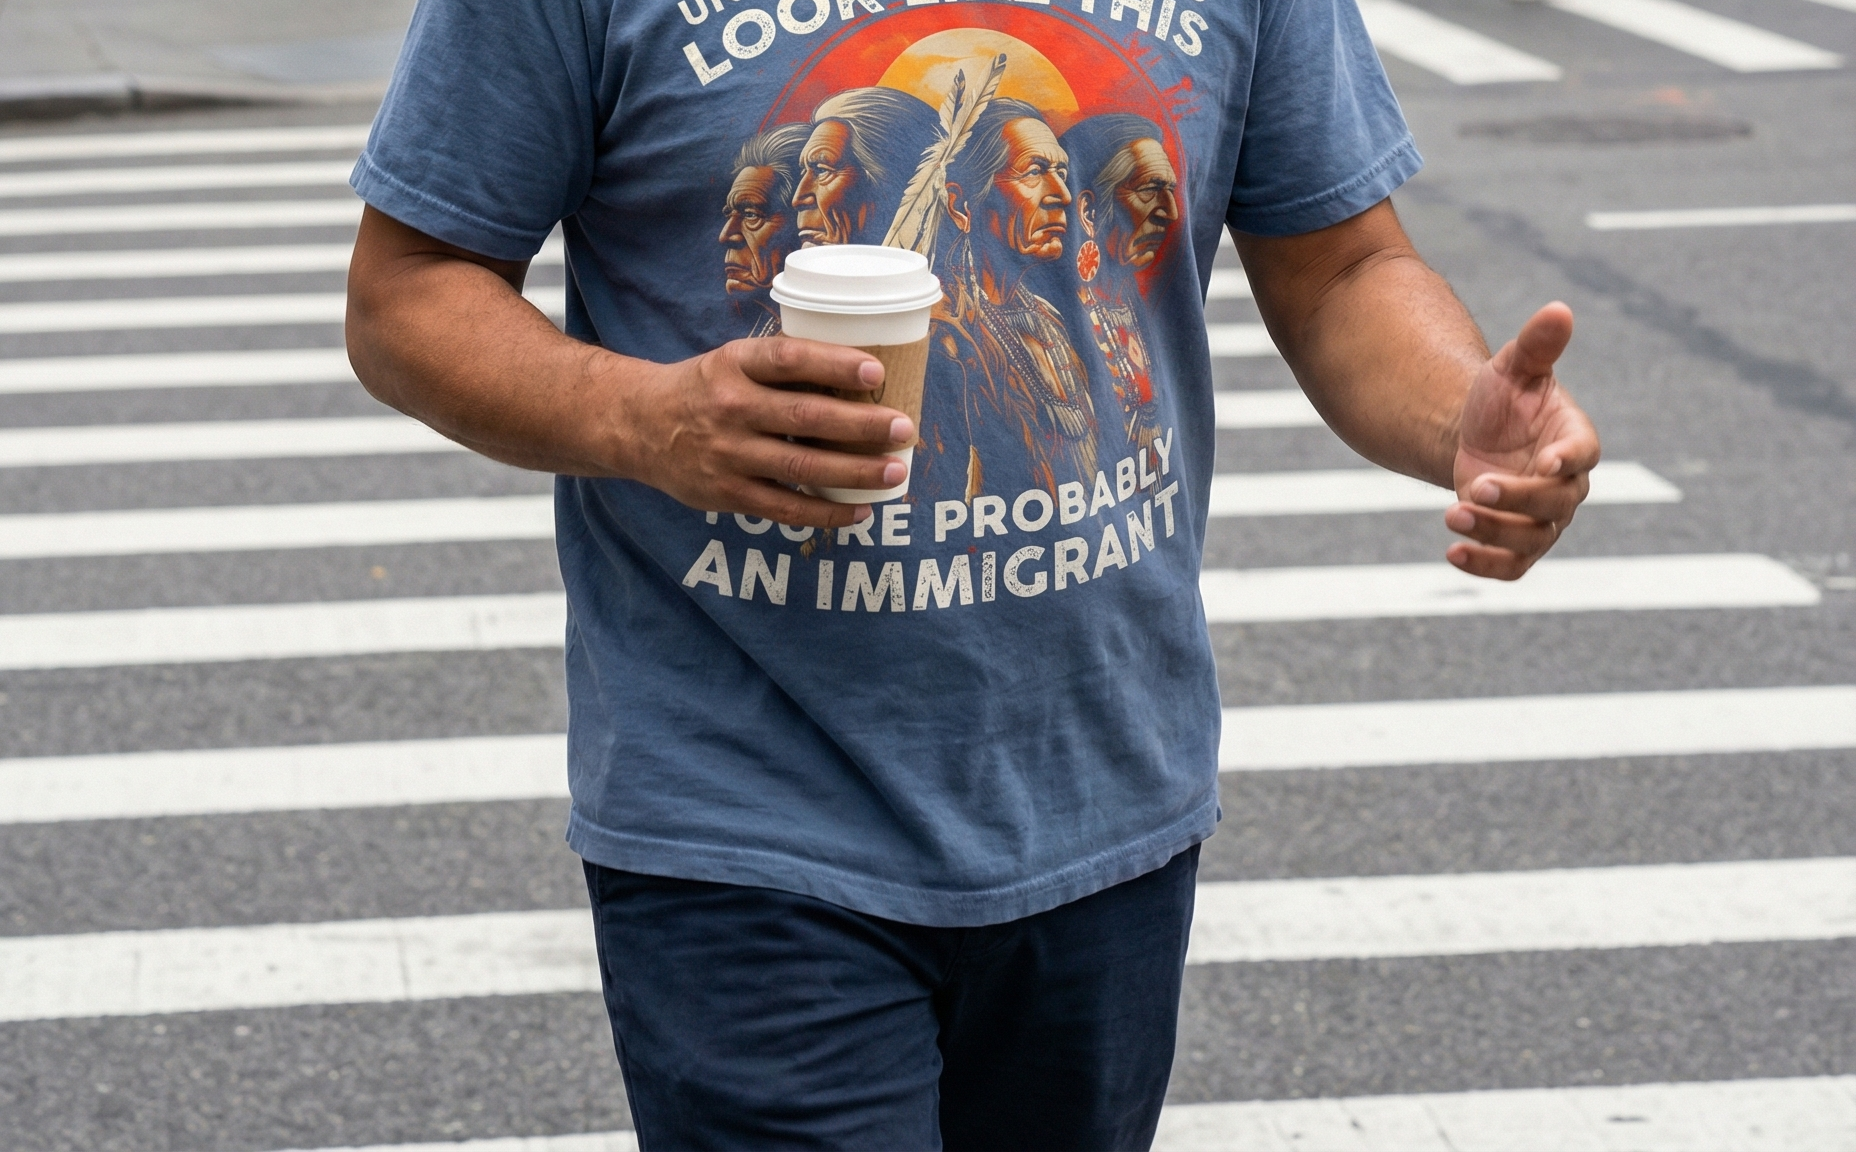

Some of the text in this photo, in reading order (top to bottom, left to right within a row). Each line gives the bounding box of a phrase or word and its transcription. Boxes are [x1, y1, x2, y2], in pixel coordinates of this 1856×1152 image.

[682, 539, 791, 606] AN
[816, 480, 1179, 613] IMMIGRANT
[934, 427, 1174, 543] PROBABLY
